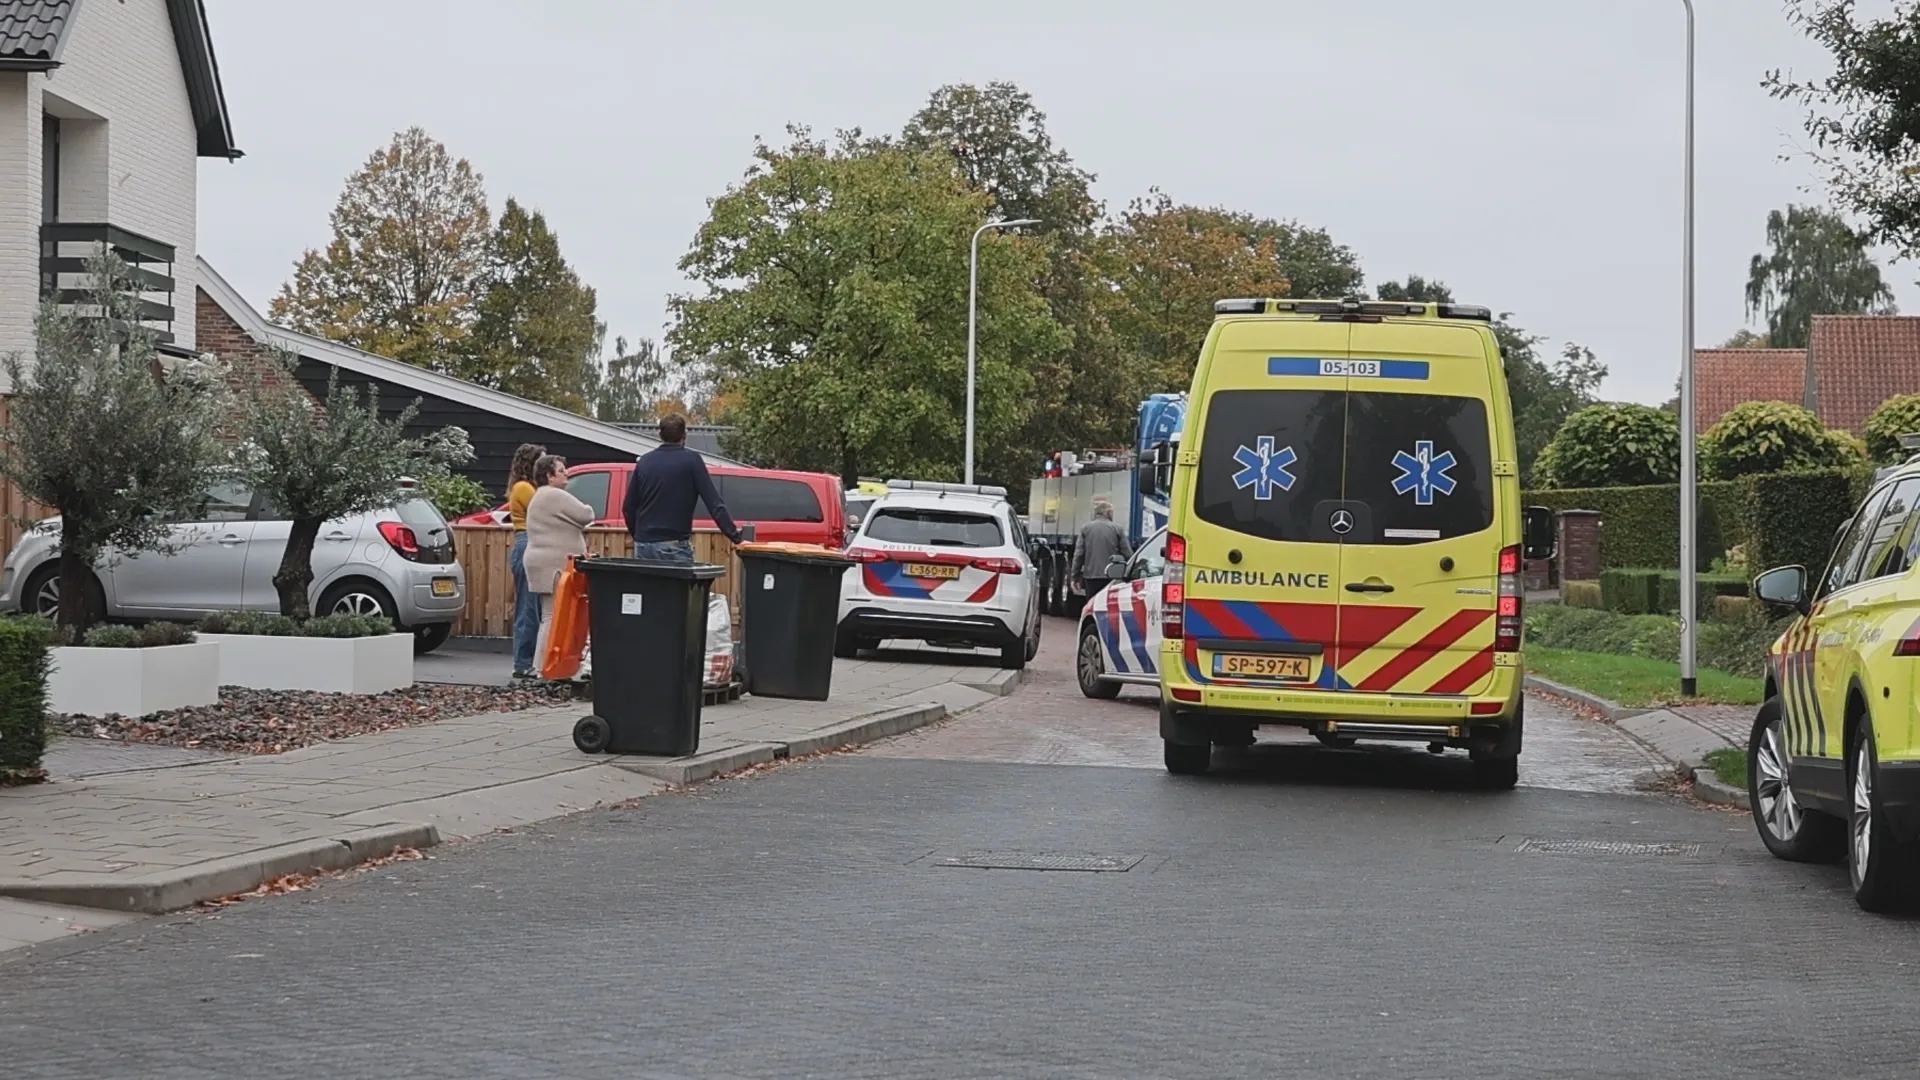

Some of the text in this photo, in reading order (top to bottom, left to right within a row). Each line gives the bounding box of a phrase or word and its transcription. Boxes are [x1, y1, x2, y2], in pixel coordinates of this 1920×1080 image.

[1324, 361, 1377, 375] 05-103
[1194, 569, 1329, 588] AMBULANCE
[1227, 657, 1302, 676] SP-597-K
